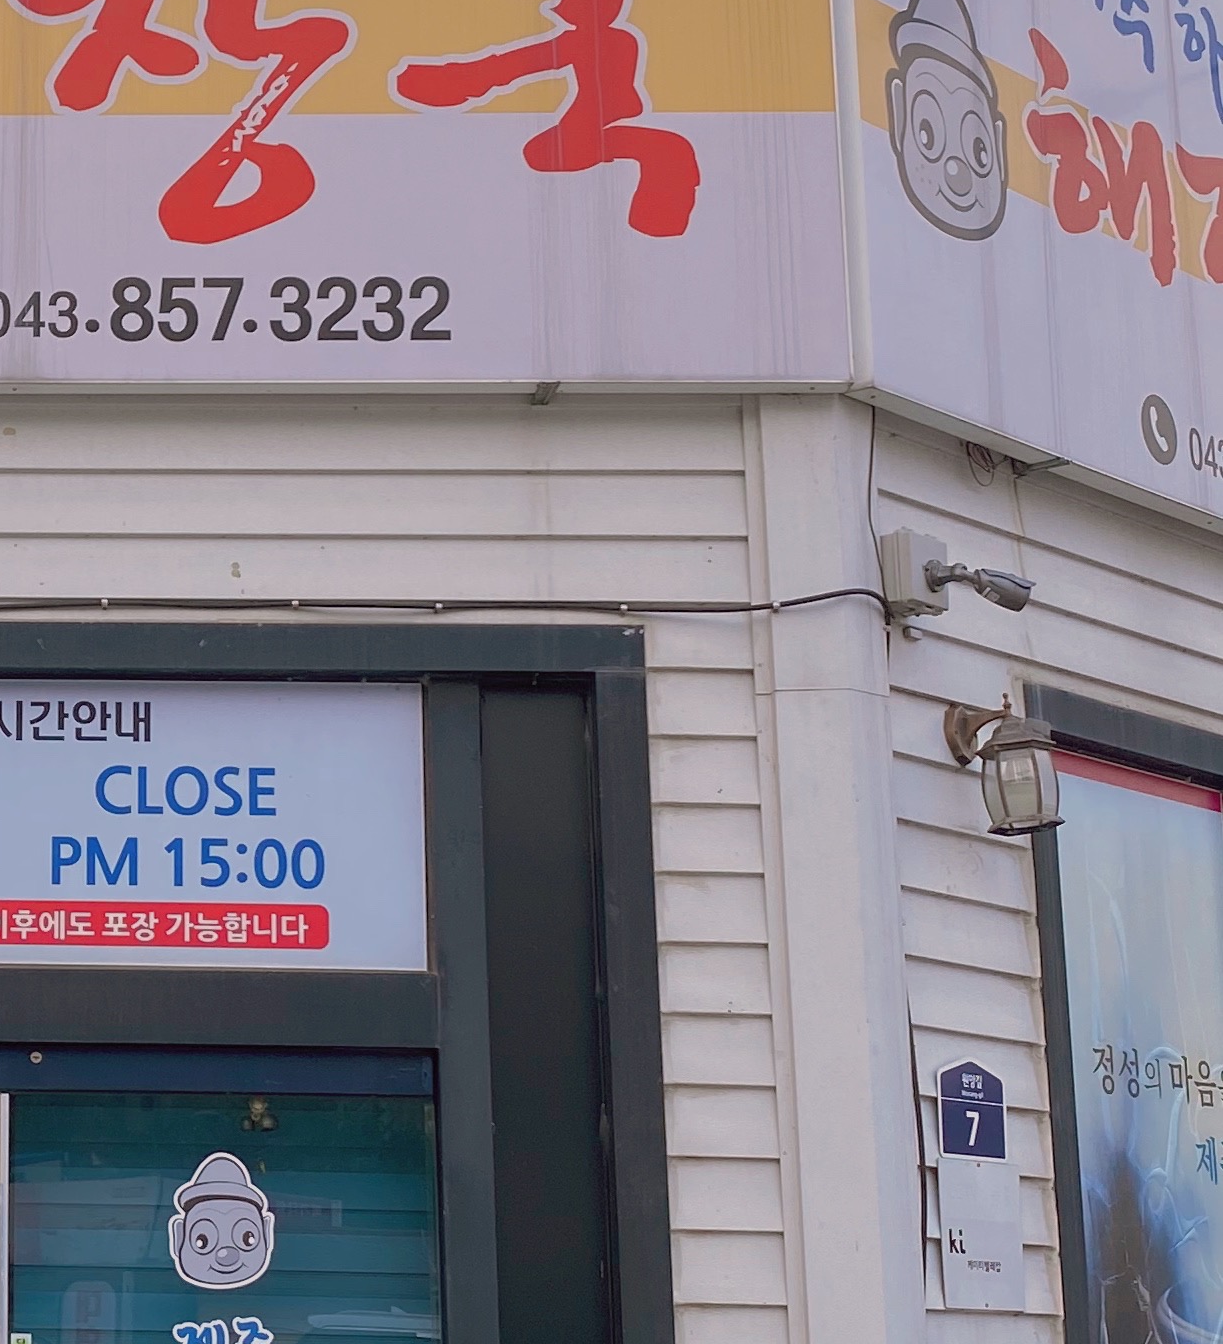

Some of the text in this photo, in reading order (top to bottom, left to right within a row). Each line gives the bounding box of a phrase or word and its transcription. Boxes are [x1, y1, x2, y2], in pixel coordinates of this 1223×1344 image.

[94, 764, 278, 818] CLOSE
[50, 835, 326, 891] PM 15:00
[102, 911, 159, 943] 포장
[166, 913, 310, 945] 가능합니다
[1093, 1044, 1223, 1108] 정성의 마음
[965, 1110, 980, 1146] 7
[1195, 1136, 1223, 1185] 제
